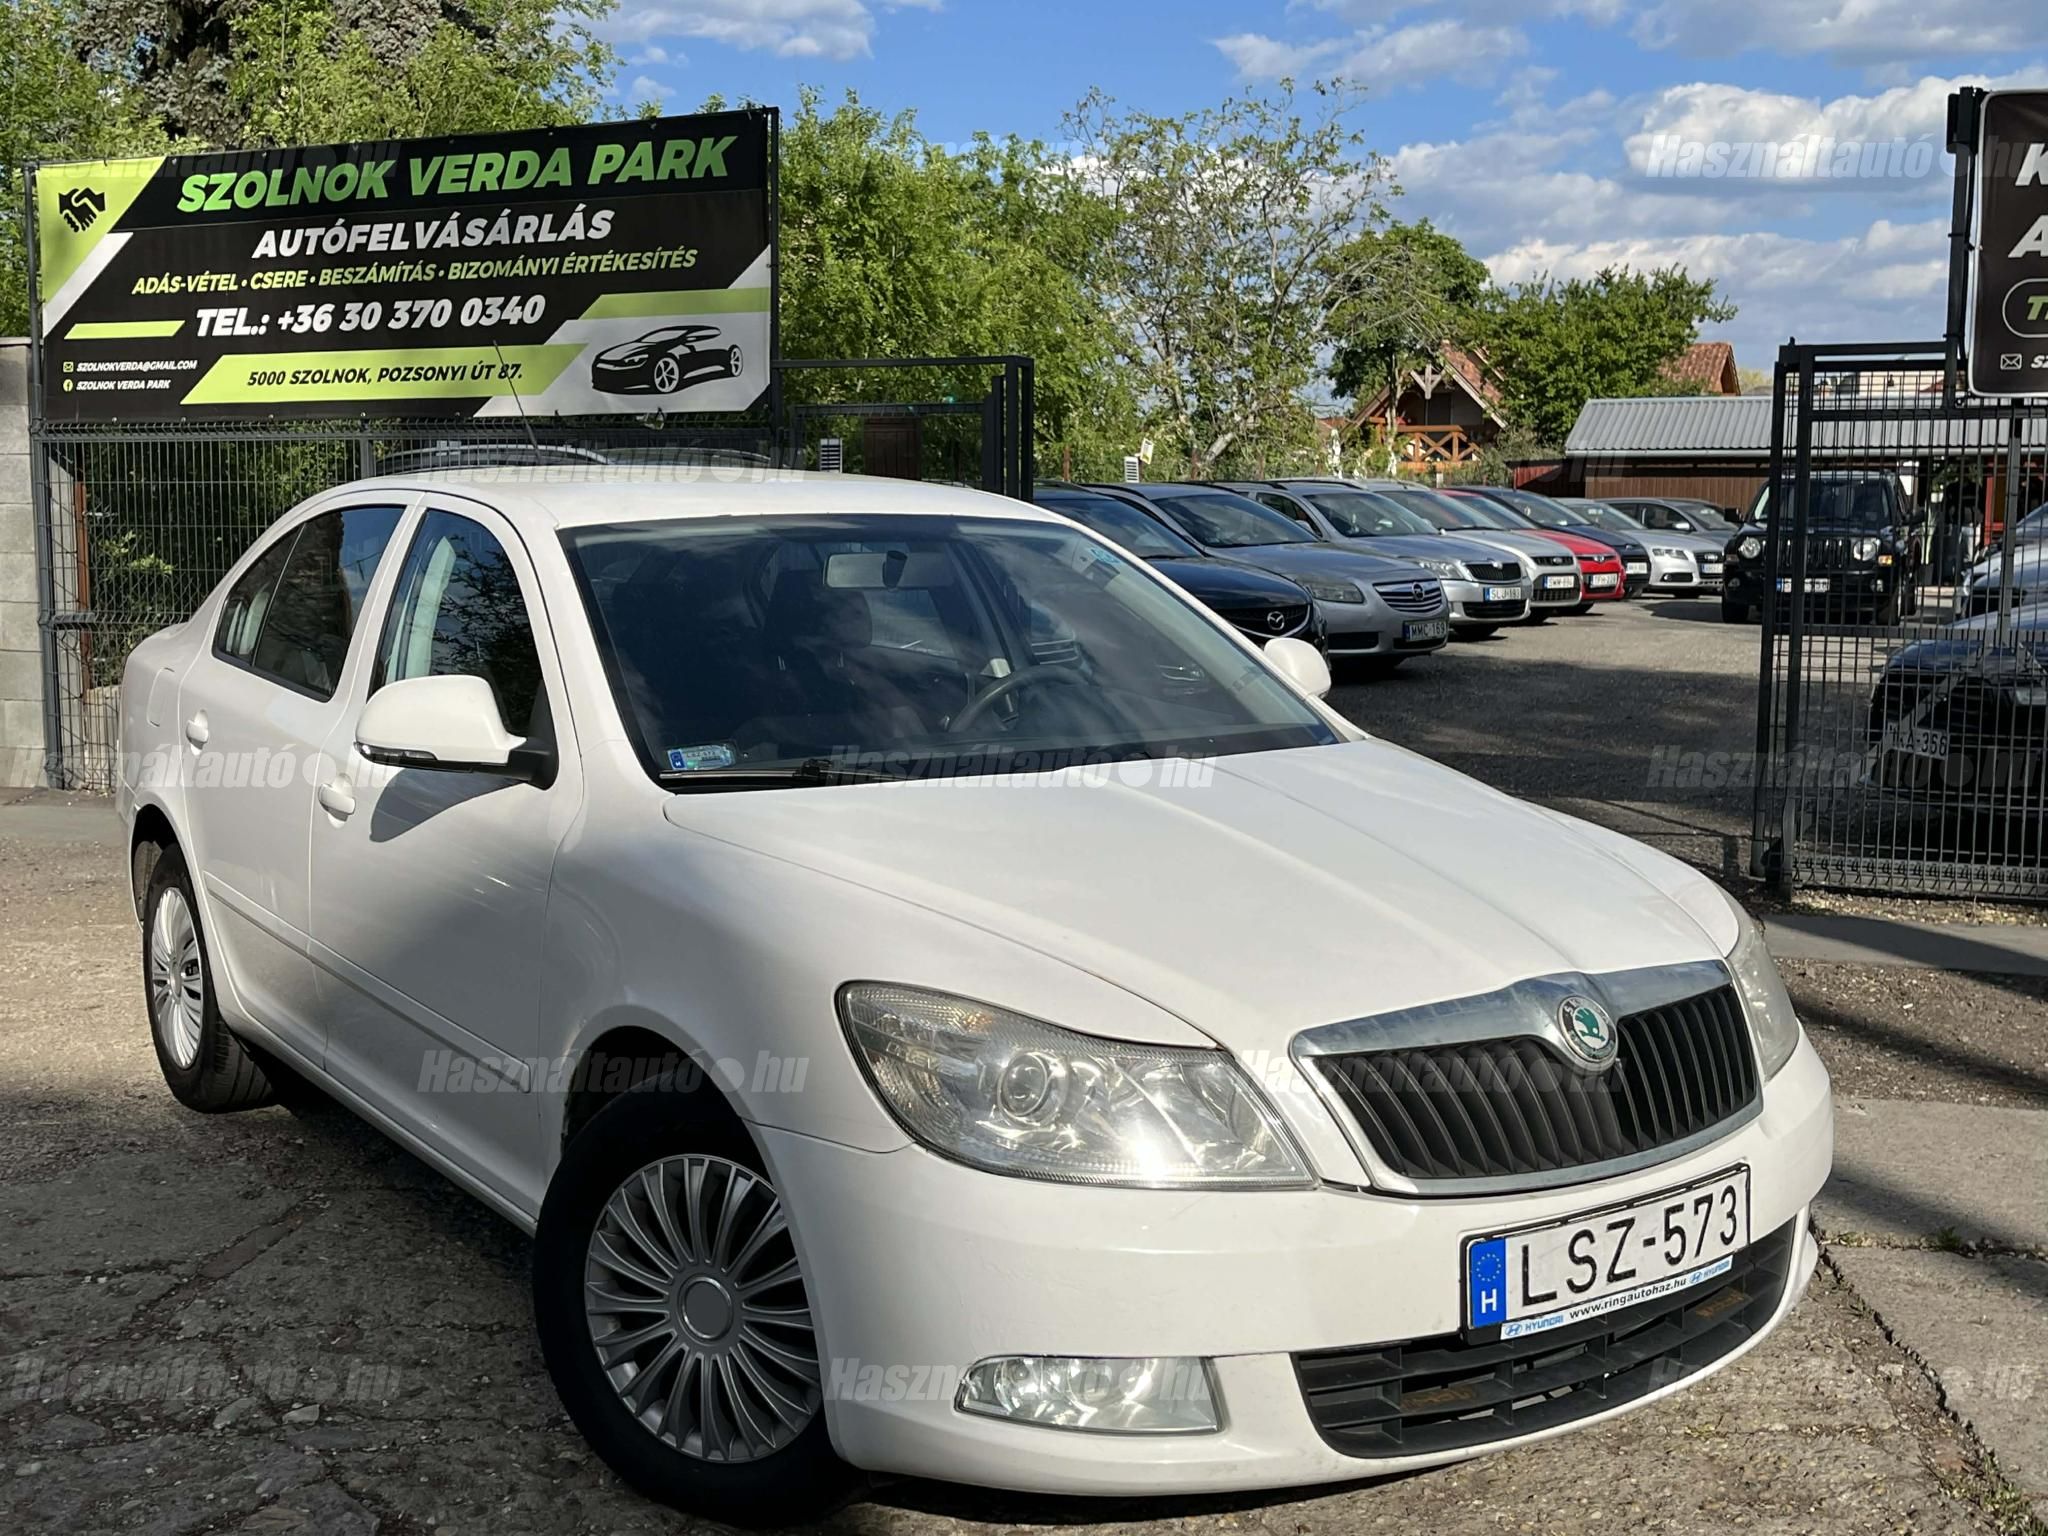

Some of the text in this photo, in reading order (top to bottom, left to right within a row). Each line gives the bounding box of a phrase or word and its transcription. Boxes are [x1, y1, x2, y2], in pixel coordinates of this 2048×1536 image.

[177, 135, 738, 212] SZOLNOK VERDA PARK
[252, 203, 615, 259] AUTÓFELVÁSÁRLÁS
[132, 245, 698, 295] ADÁS-VÉTEL CSERE BESZÁMÍTÁS BIZOMÁNYI ÉRTÉKESÍTÉS
[196, 294, 547, 337] TEL.: +36 30 370 0340
[76, 360, 198, 372] SZOLNOKVERDA@GMAIL.COM
[76, 379, 171, 391] SZOLNOK VERDA PARK
[247, 361, 522, 386] 5000 SZOLNOK, POZSONYI ÚT 87.
[1521, 1184, 1738, 1307] LSZ-573
[1481, 1289, 1497, 1314] H
[1569, 1277, 1687, 1320] www.ringautohaz.hu
[1525, 1314, 1564, 1332] HYUNDAI
